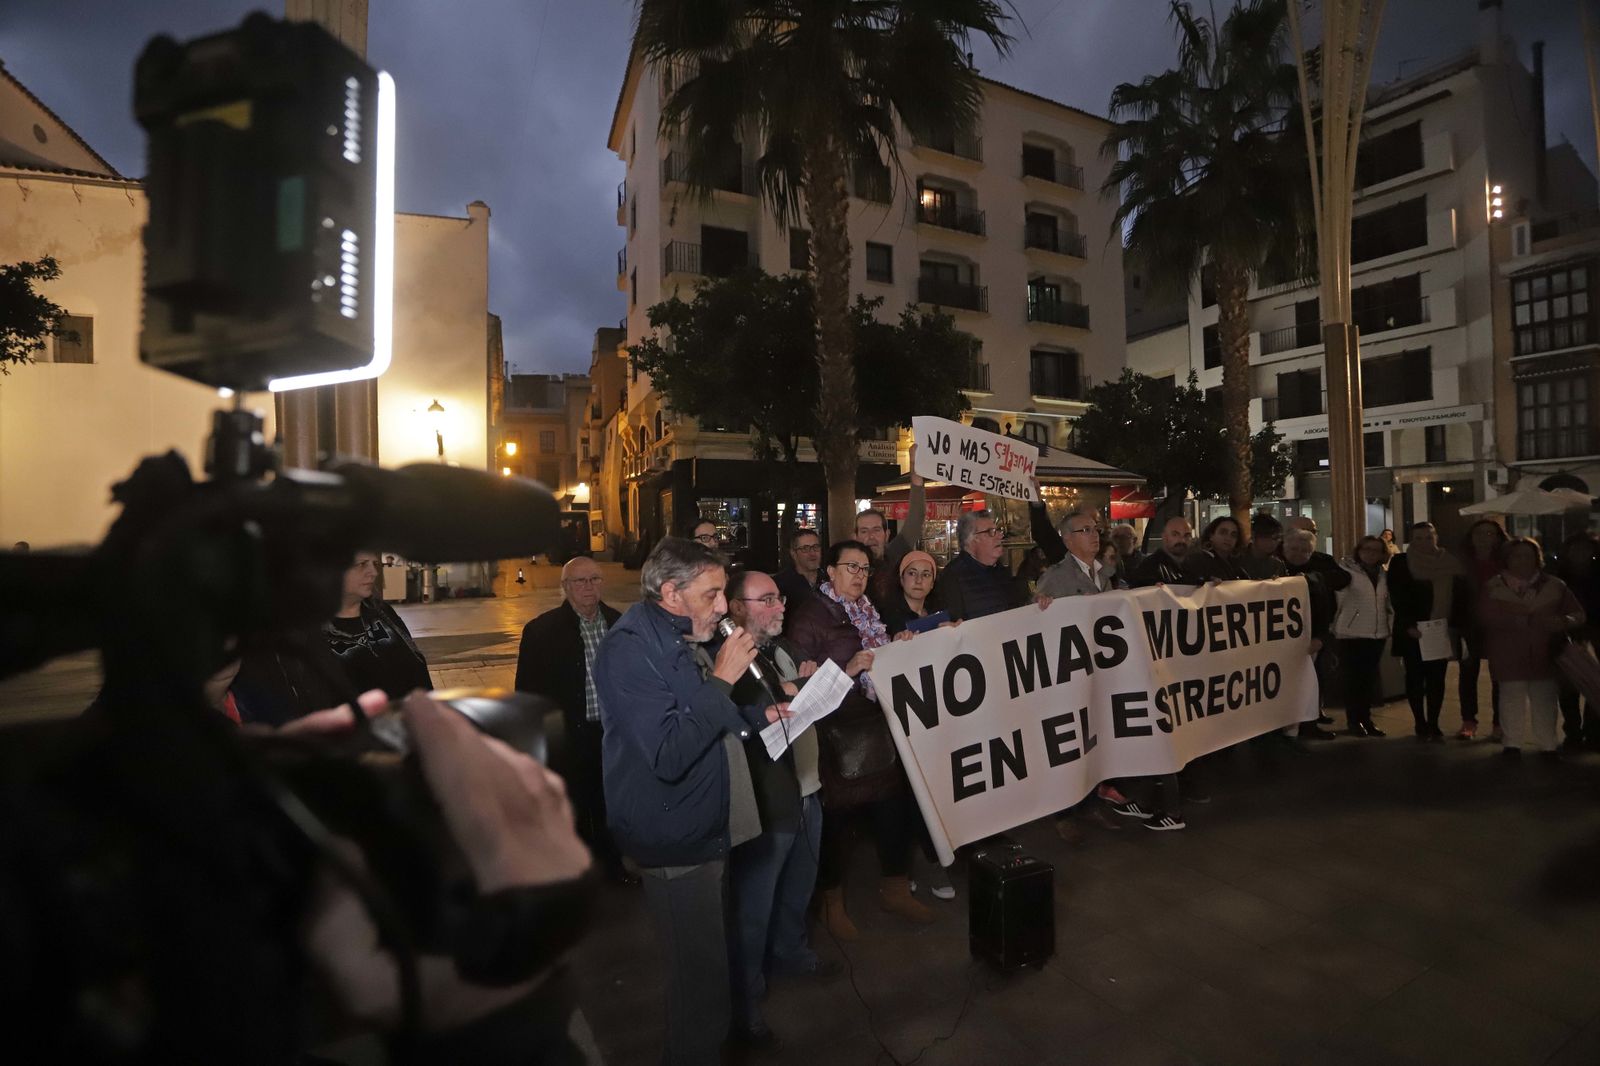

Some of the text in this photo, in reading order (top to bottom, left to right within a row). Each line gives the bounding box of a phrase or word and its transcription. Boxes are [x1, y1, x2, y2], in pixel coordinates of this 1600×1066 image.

[927, 431, 1034, 474] NO MAS MUERTES
[1304, 427, 1329, 435] ABOGAD
[936, 462, 1031, 499] EN EL ESTRECHO
[890, 653, 986, 737] NO
[1001, 614, 1129, 699] MAS
[1142, 596, 1303, 661] MUERTES
[950, 662, 1281, 803] EN EL ESTRECHO
